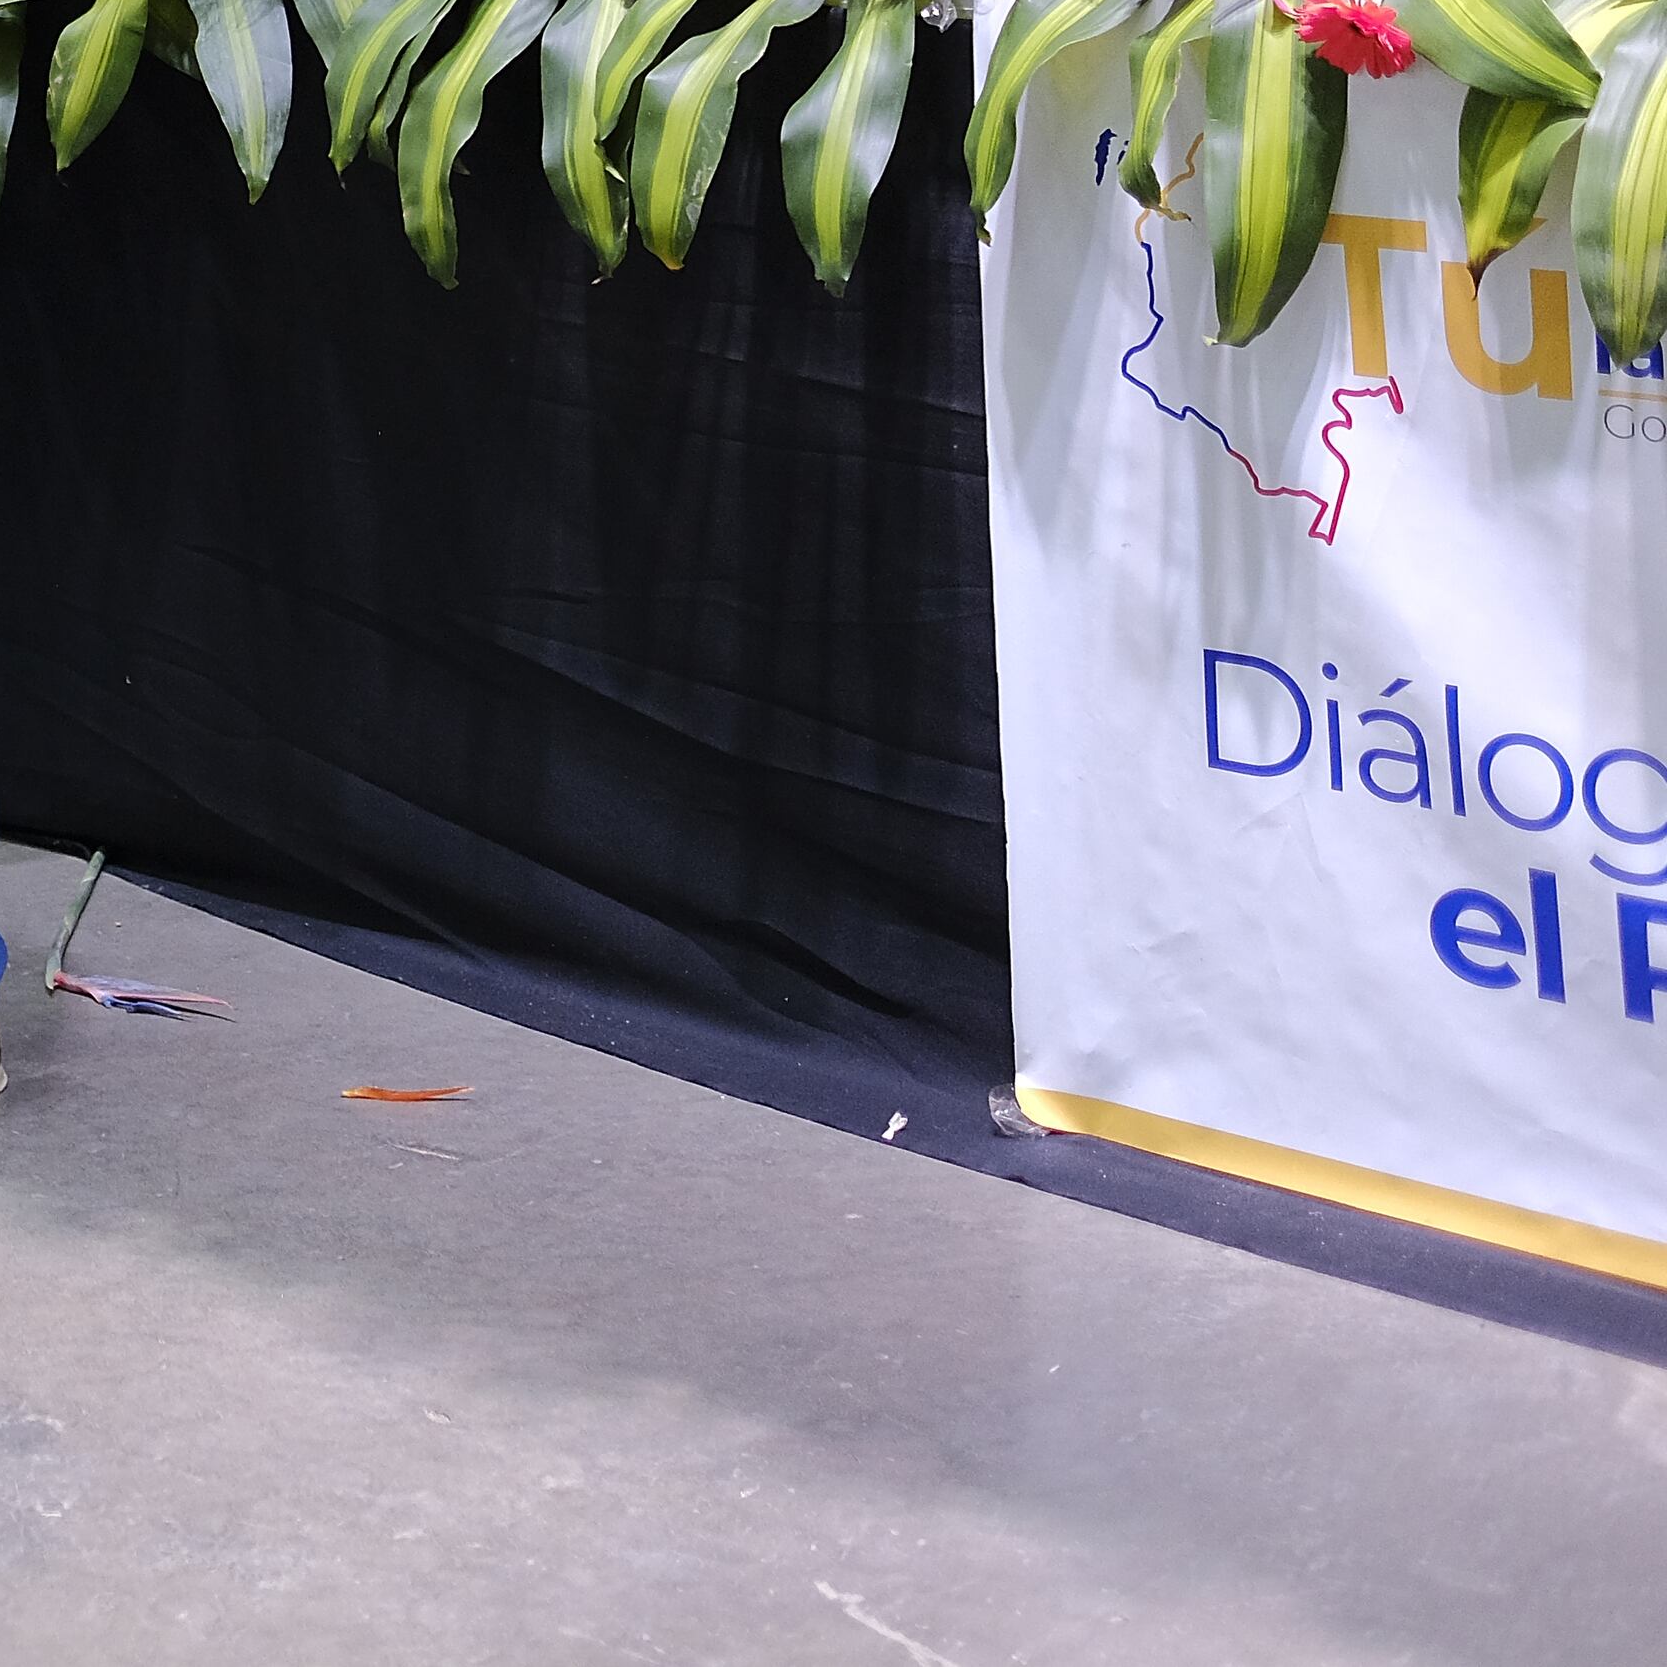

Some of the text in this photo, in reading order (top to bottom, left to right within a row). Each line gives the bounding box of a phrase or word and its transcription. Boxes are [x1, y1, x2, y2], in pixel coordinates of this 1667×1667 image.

[1604, 404, 1667, 442] Go
[1203, 648, 1667, 886] Diálog
[1430, 867, 1566, 1003] el
